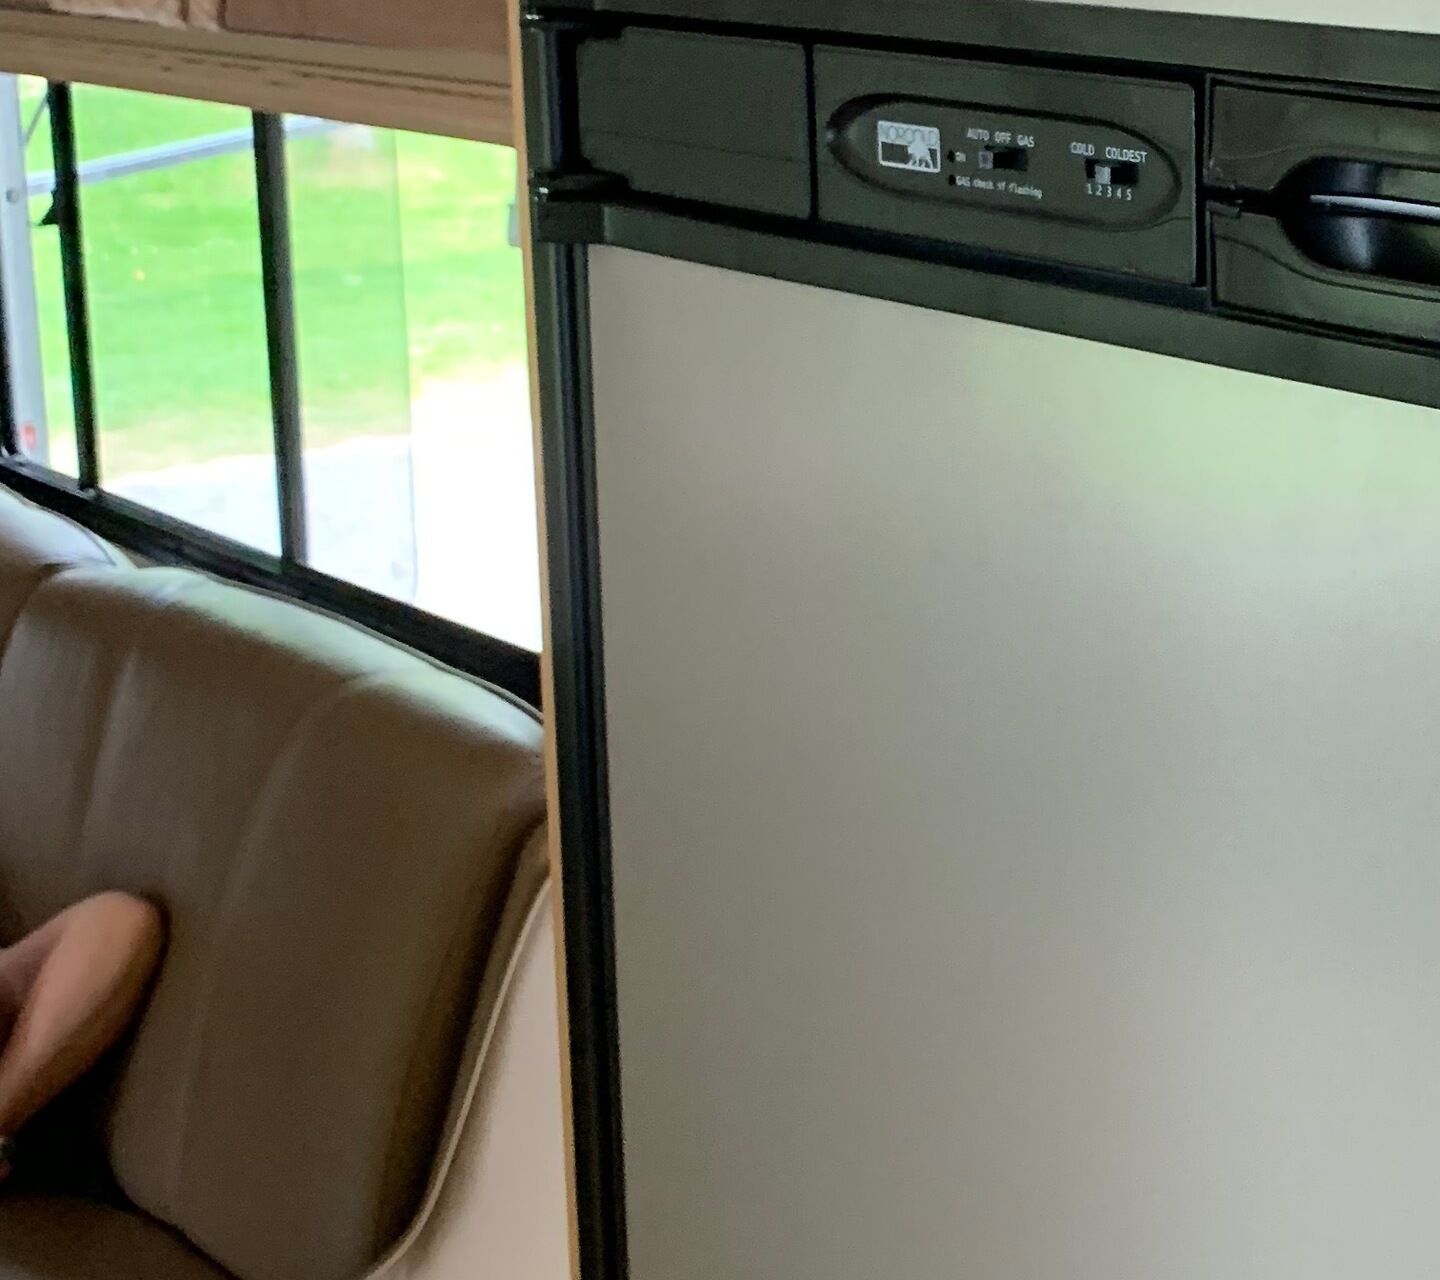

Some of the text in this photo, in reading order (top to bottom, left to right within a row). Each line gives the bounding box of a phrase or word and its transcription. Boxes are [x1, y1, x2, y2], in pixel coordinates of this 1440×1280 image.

[966, 128, 1035, 148] AUTO OFF GAS
[1070, 142, 1148, 163] COLD COLDEST
[1086, 183, 1132, 201] 1 2 3 4 5
